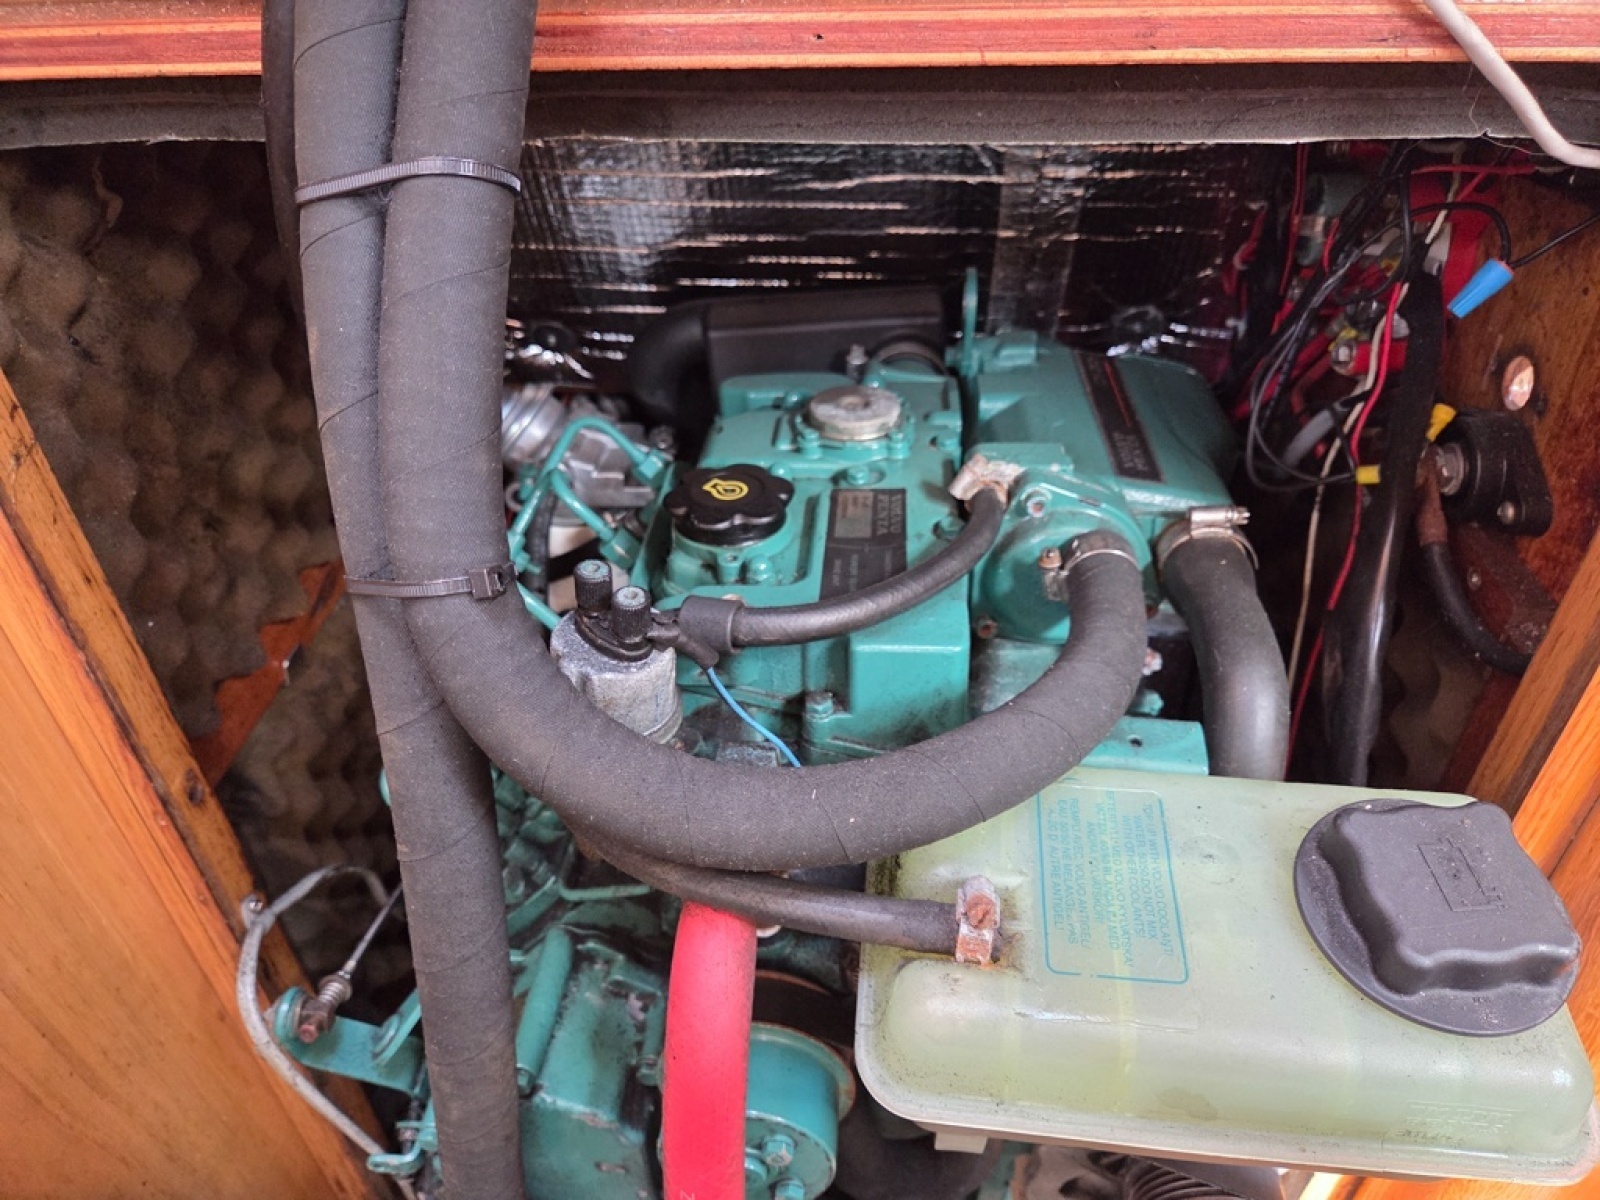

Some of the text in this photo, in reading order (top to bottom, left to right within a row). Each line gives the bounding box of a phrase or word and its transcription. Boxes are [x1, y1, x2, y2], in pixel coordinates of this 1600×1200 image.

[1121, 815, 1133, 839] WITH
[1072, 834, 1082, 859] AVEC
[1124, 840, 1137, 874] OTHER
[1147, 838, 1160, 864] WITH
[1074, 863, 1086, 896] VOLVO
[1114, 868, 1126, 902] VOLVO
[1151, 867, 1165, 899] VOLVO
[1143, 897, 1155, 917] NOT
[1146, 919, 1158, 940] MIX
